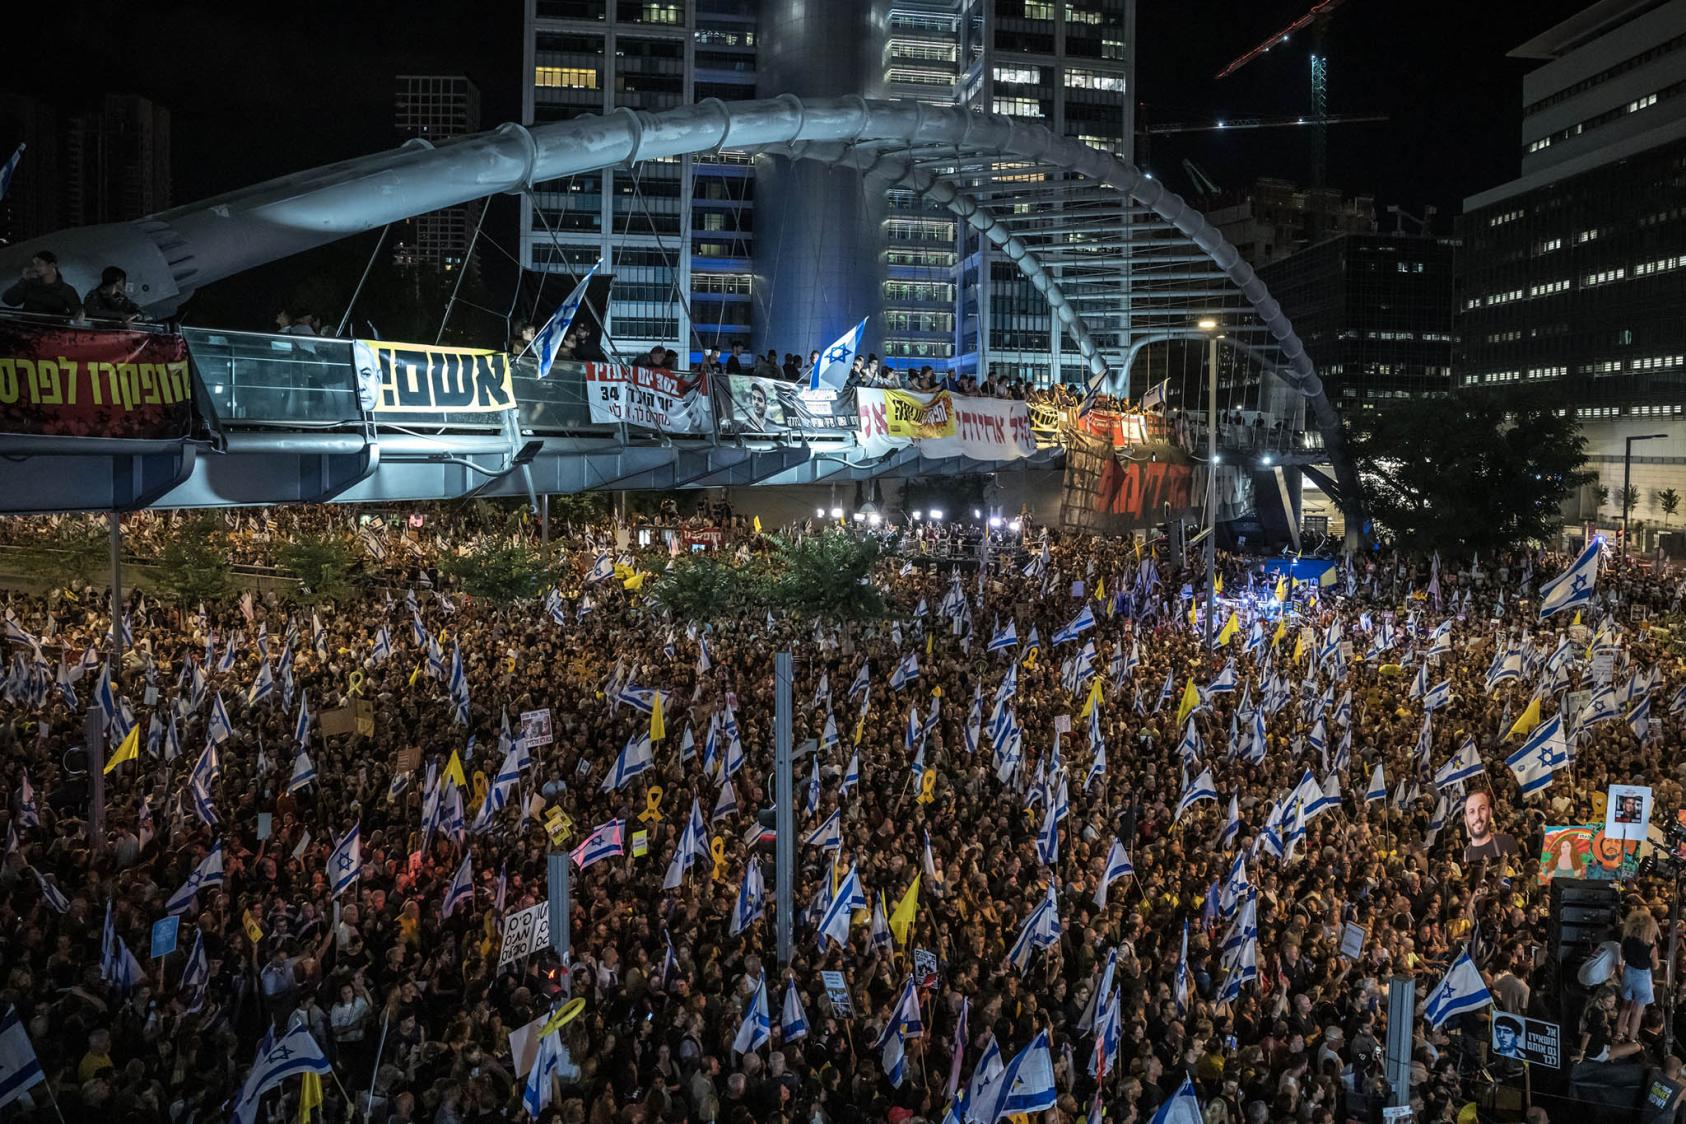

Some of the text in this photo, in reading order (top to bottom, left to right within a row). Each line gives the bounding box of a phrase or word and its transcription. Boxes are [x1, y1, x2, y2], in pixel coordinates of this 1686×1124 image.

[379, 348, 510, 407] אשם!
[88, 360, 191, 411] הופקרו
[601, 386, 619, 401] 34
[1546, 1026, 1557, 1037] אל
[1527, 1041, 1557, 1055] גם אותם
[1543, 1054, 1557, 1065] לבד
